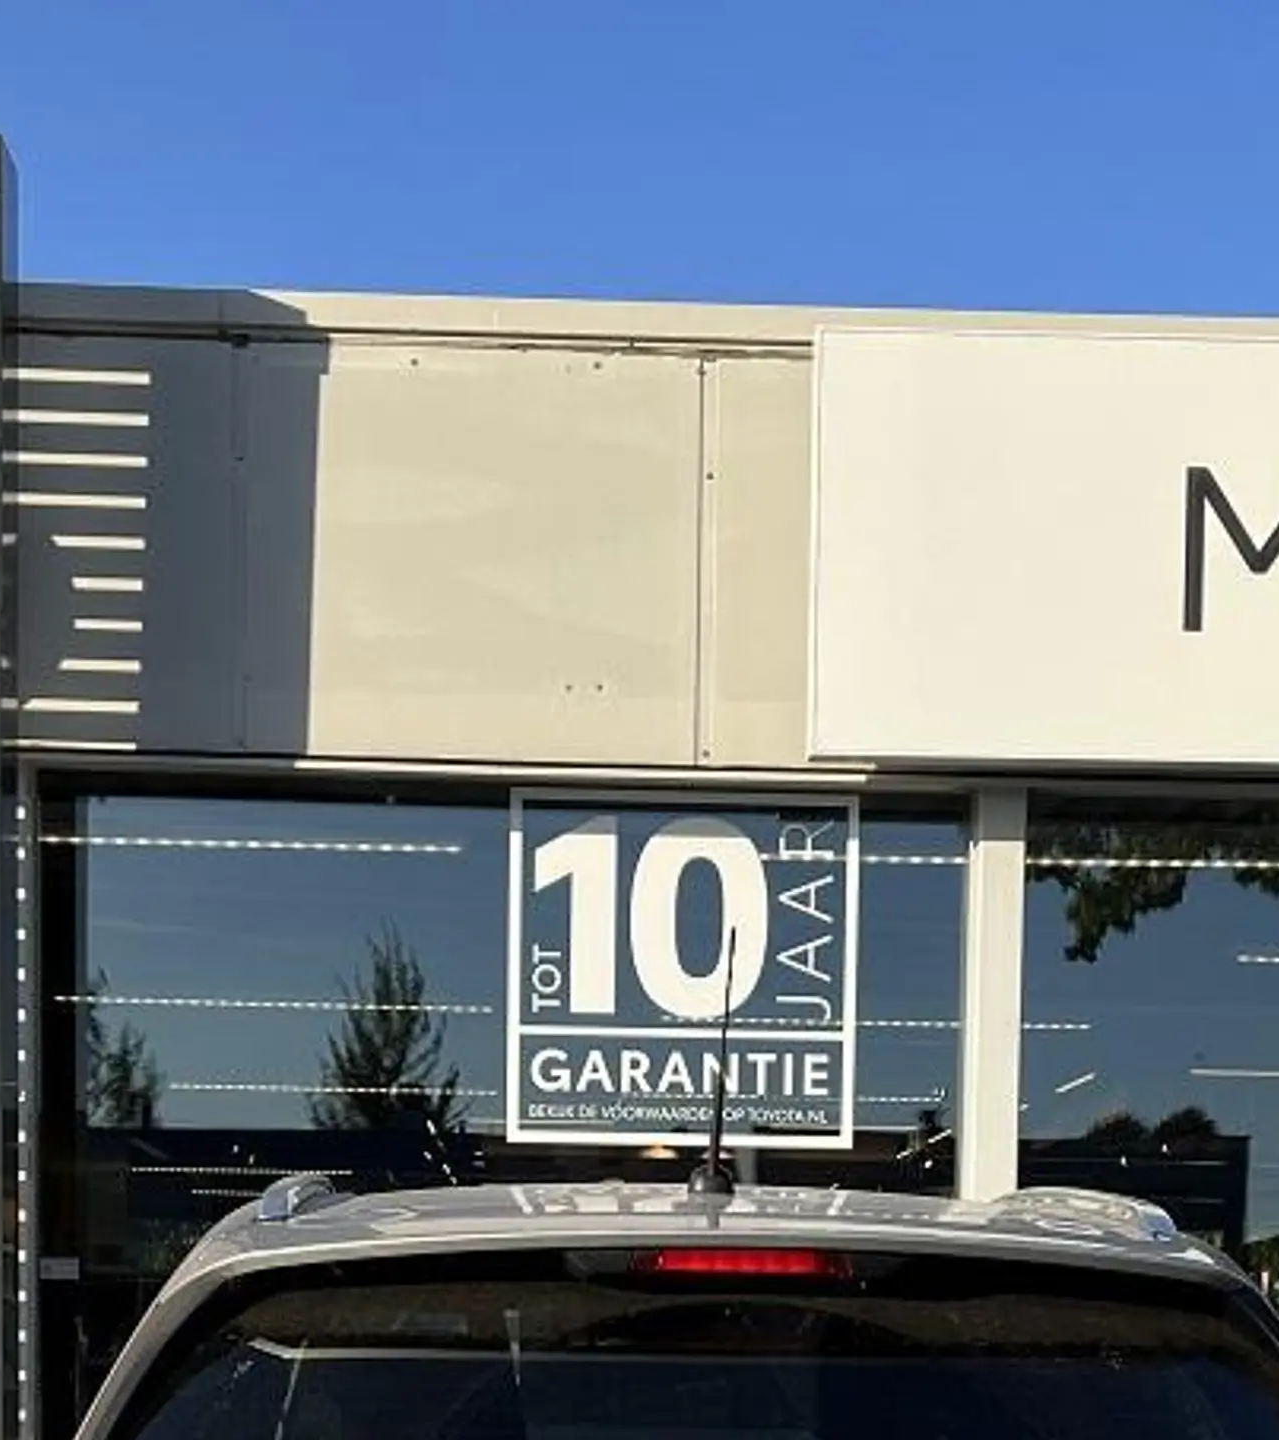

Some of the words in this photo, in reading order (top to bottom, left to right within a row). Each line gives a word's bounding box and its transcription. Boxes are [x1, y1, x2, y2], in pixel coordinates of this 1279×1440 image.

[531, 945, 562, 1013] TOT
[533, 815, 768, 1020] 10
[775, 817, 835, 1024] JAAR
[531, 1049, 829, 1096] GARANTIE
